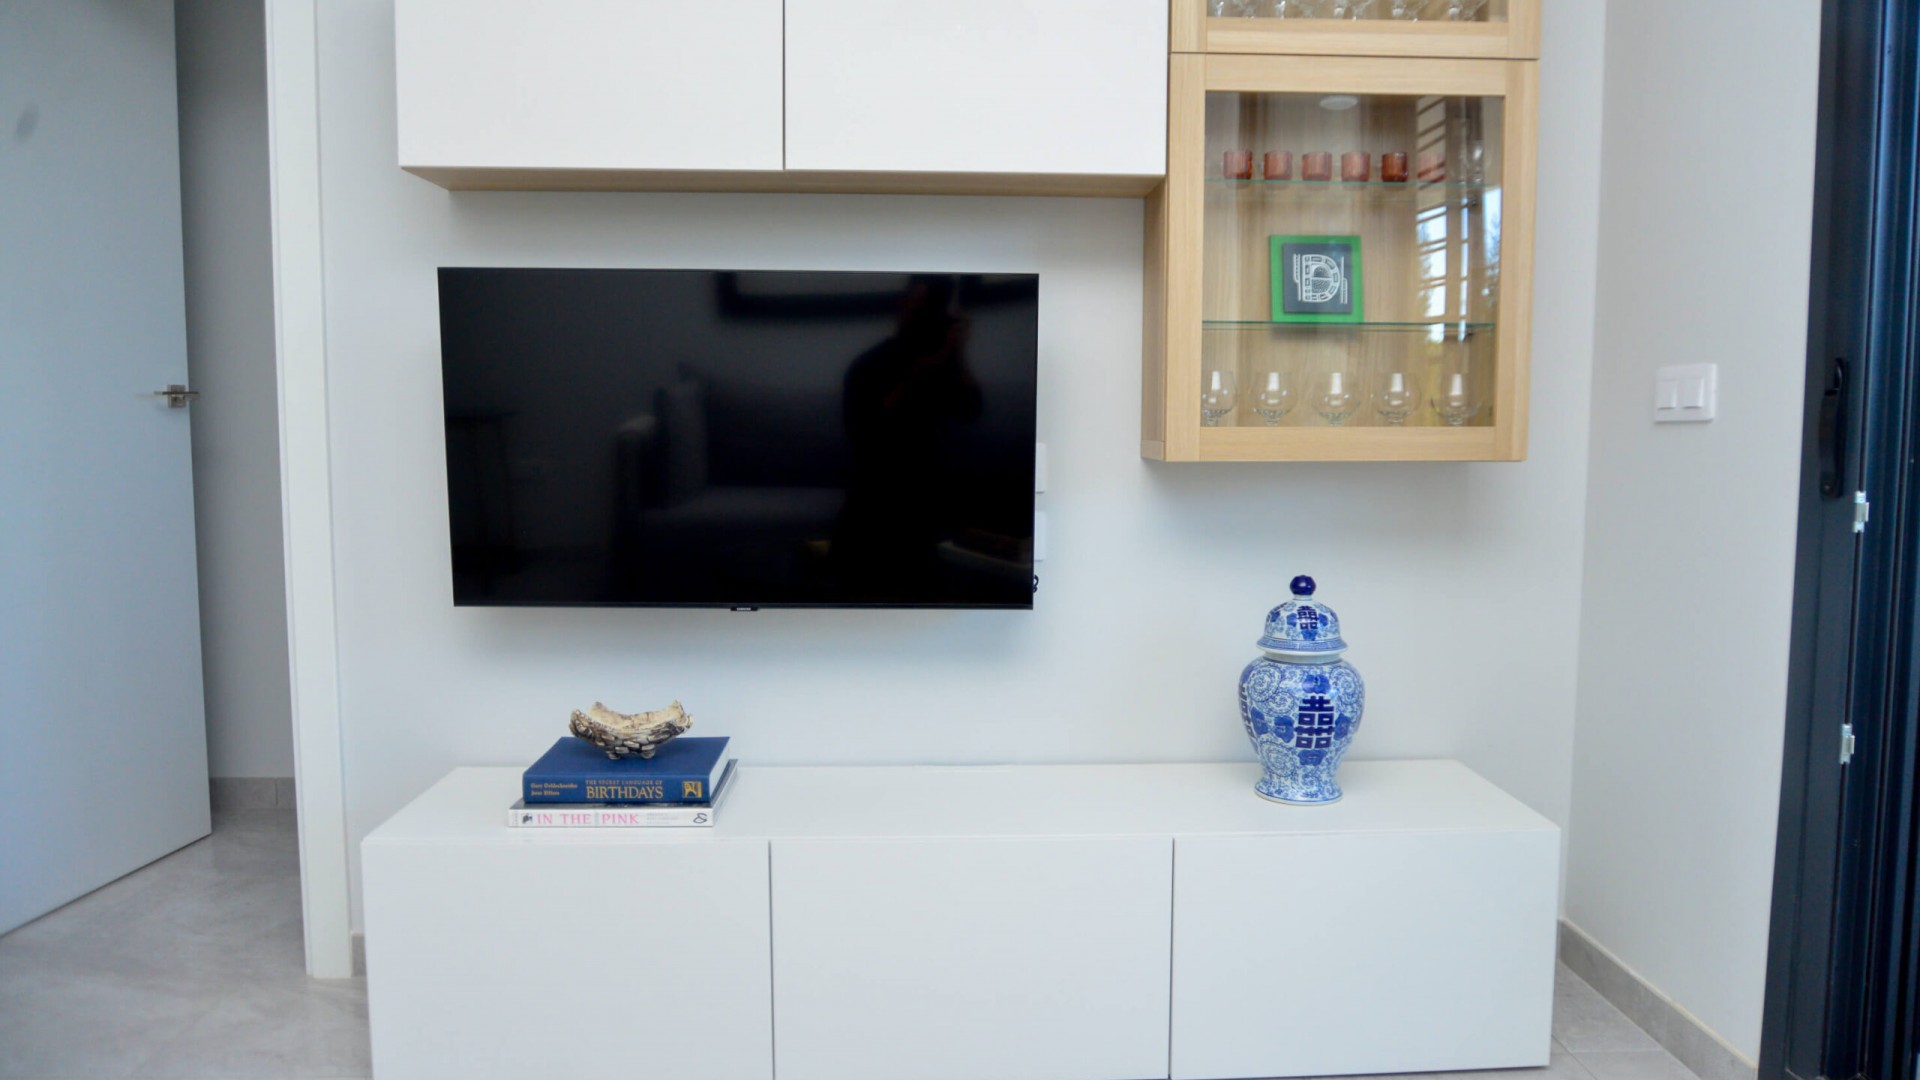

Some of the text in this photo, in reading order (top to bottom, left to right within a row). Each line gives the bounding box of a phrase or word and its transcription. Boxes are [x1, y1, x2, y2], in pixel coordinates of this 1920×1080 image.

[586, 786, 664, 799] BIRTHDAYS
[537, 813, 553, 825] IN
[559, 813, 592, 825] THE
[601, 813, 640, 825] PINK
